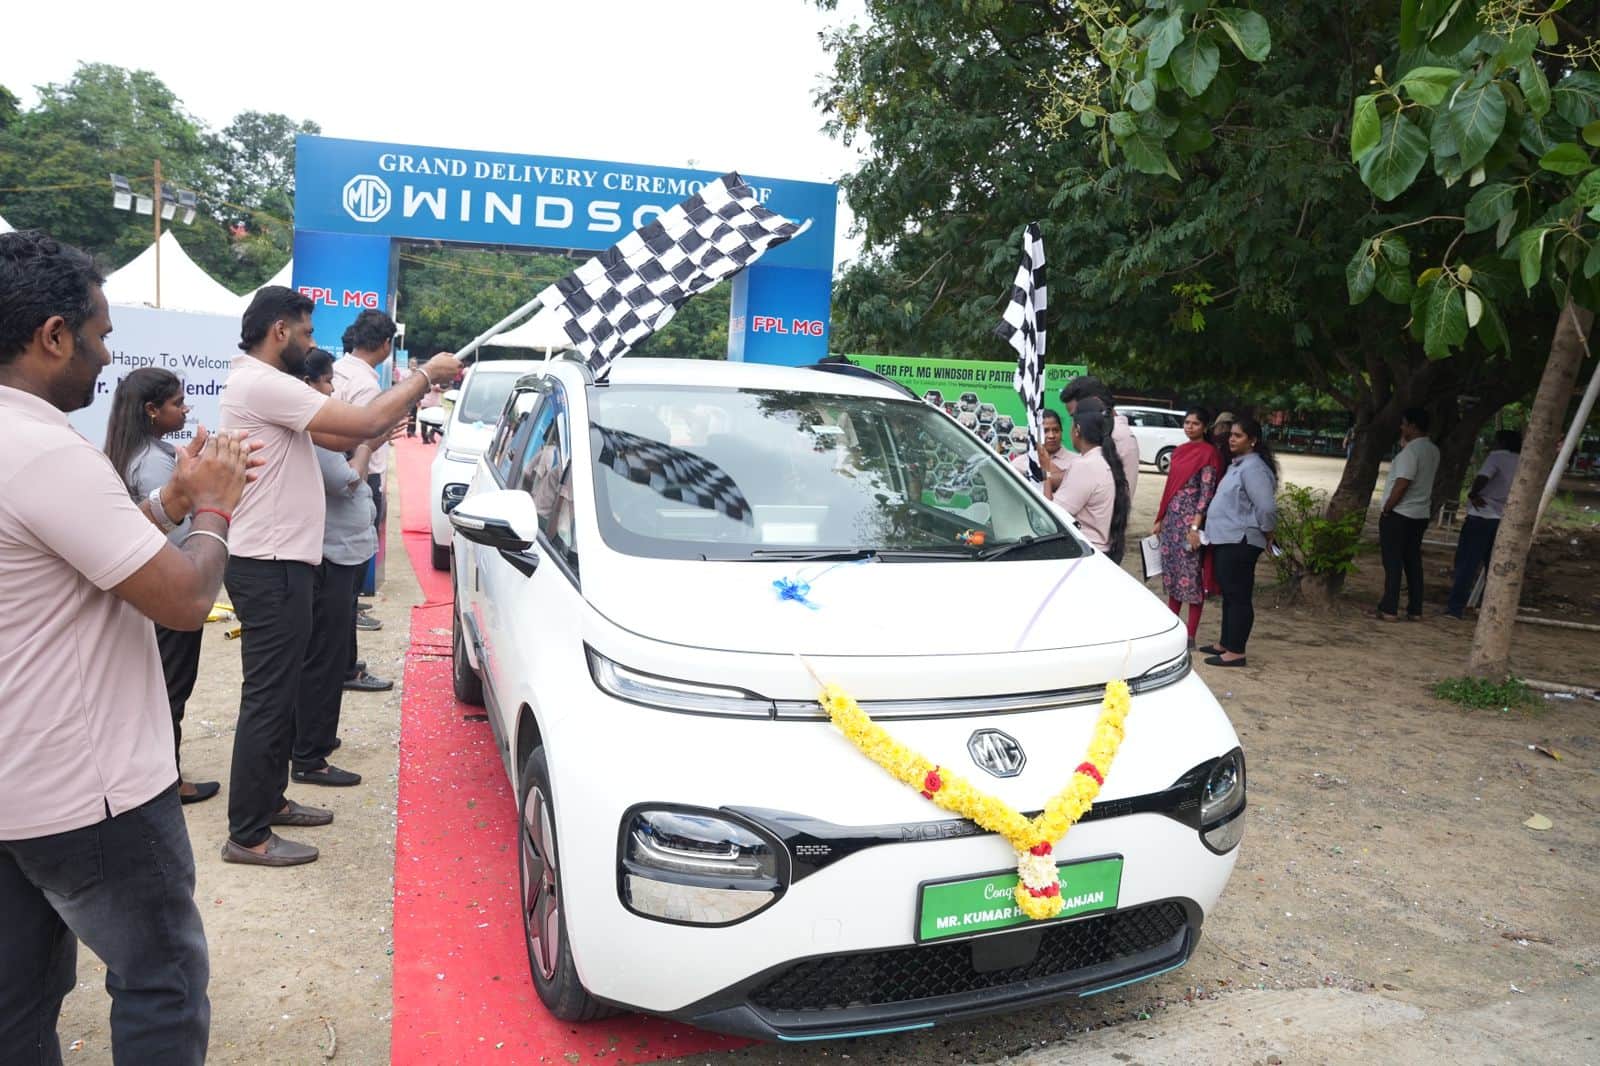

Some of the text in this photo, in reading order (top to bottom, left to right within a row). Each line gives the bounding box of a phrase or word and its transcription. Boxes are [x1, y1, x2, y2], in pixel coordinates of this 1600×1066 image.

[378, 153, 467, 177] GRAND
[474, 161, 598, 188] DELIVERY
[603, 172, 711, 197] CEREMO
[346, 177, 389, 219] MG
[403, 185, 666, 233] WINDSO
[298, 286, 338, 306] FPL
[343, 289, 379, 309] MG
[752, 315, 788, 334] FPL
[792, 318, 824, 337] MG
[112, 351, 232, 369] Happy To Welcom
[875, 364, 896, 377] DEAR
[899, 365, 915, 378] FPL
[916, 367, 931, 379] MG
[934, 368, 974, 381] WINDSOR
[975, 370, 987, 382] EV
[970, 731, 1023, 775] MG
[936, 916, 961, 929] MR.
[964, 907, 1012, 925] KUMAR
